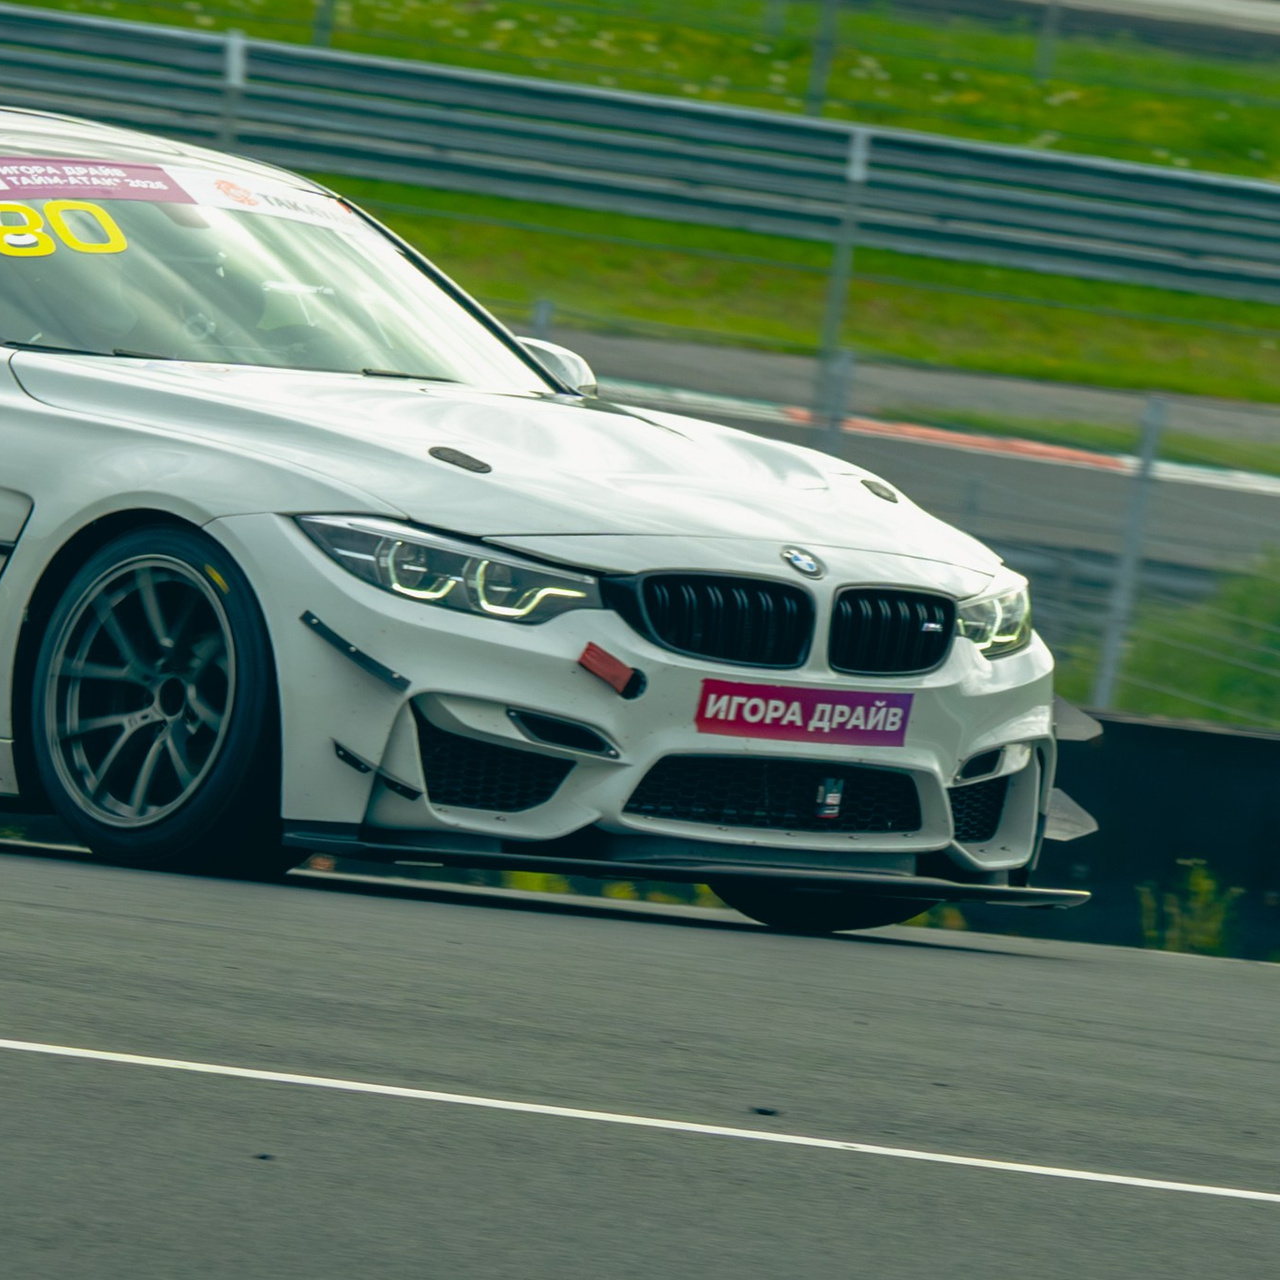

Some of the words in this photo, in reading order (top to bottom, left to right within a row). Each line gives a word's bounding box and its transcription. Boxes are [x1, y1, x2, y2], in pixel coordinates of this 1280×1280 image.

[61, 165, 128, 178] ДРАЙВ
[704, 693, 803, 727] ИГОРА
[807, 700, 904, 733] ДРАЙВ
